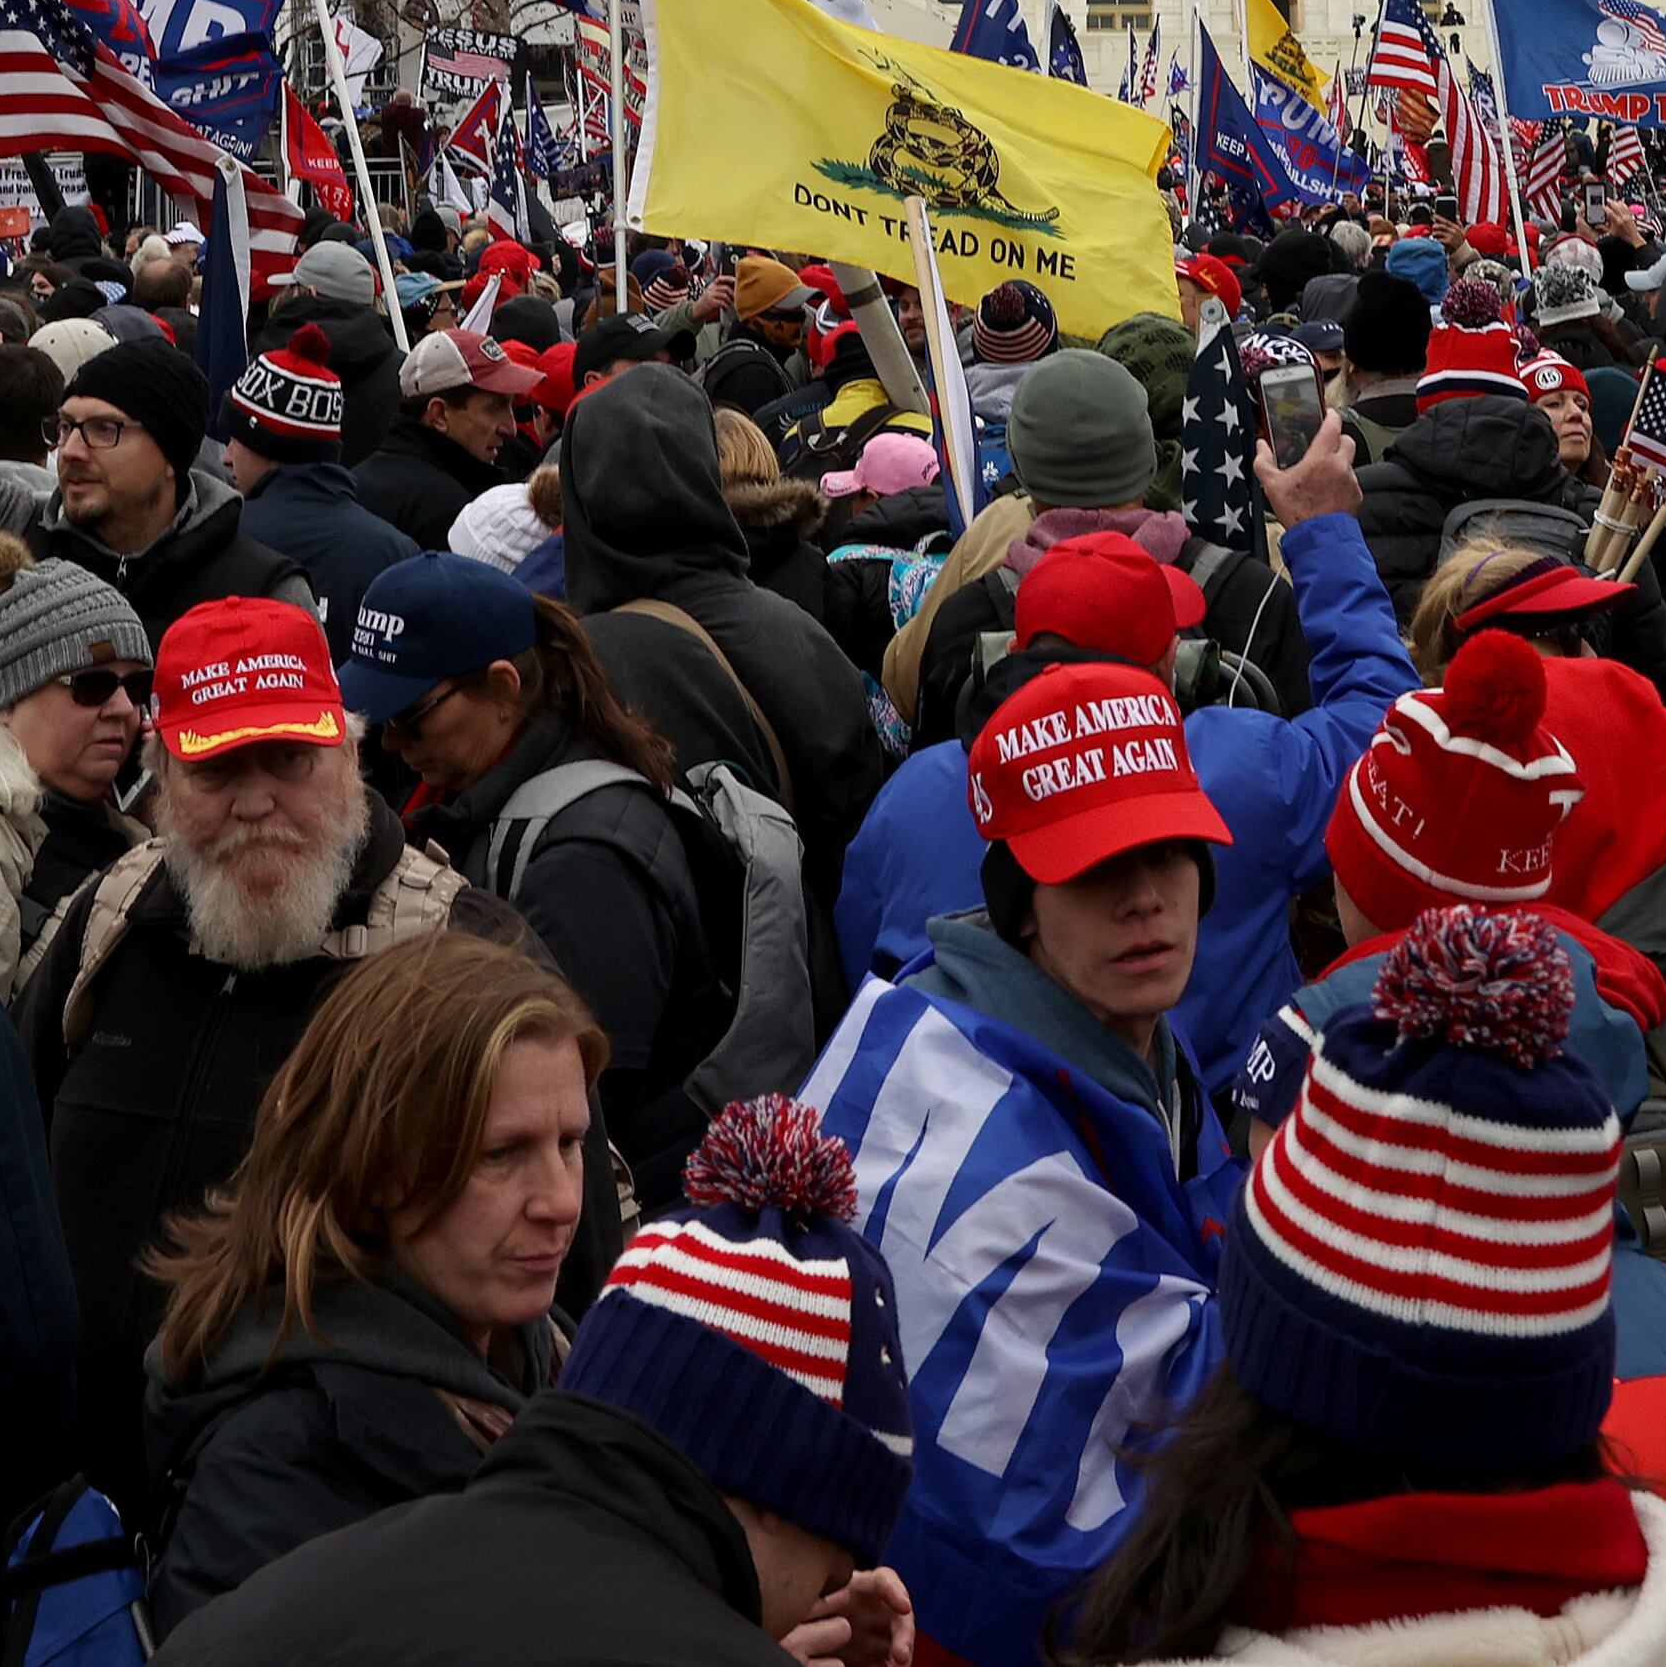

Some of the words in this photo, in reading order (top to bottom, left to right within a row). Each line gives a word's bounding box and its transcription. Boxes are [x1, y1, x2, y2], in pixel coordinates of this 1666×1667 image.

[427, 65, 489, 95] TRUM
[1542, 83, 1651, 124] TRUMP
[1216, 131, 1245, 157] KEEP
[794, 181, 869, 226] DONT
[989, 237, 1025, 270] ON
[1035, 245, 1077, 281] ME
[1538, 368, 1561, 388] 45
[285, 383, 343, 424] BOS
[357, 607, 406, 644] ump
[182, 661, 230, 690] MAKE
[235, 653, 308, 673] AMERICA
[192, 676, 248, 706] GREAT
[255, 672, 304, 690] AGAIN
[994, 710, 1073, 765] MAKE
[1074, 694, 1177, 739] AMERICA
[1022, 748, 1107, 802] GREAT
[1112, 737, 1179, 777] AGAIN
[1367, 753, 1426, 840] EAT!
[1495, 841, 1554, 875] KEE
